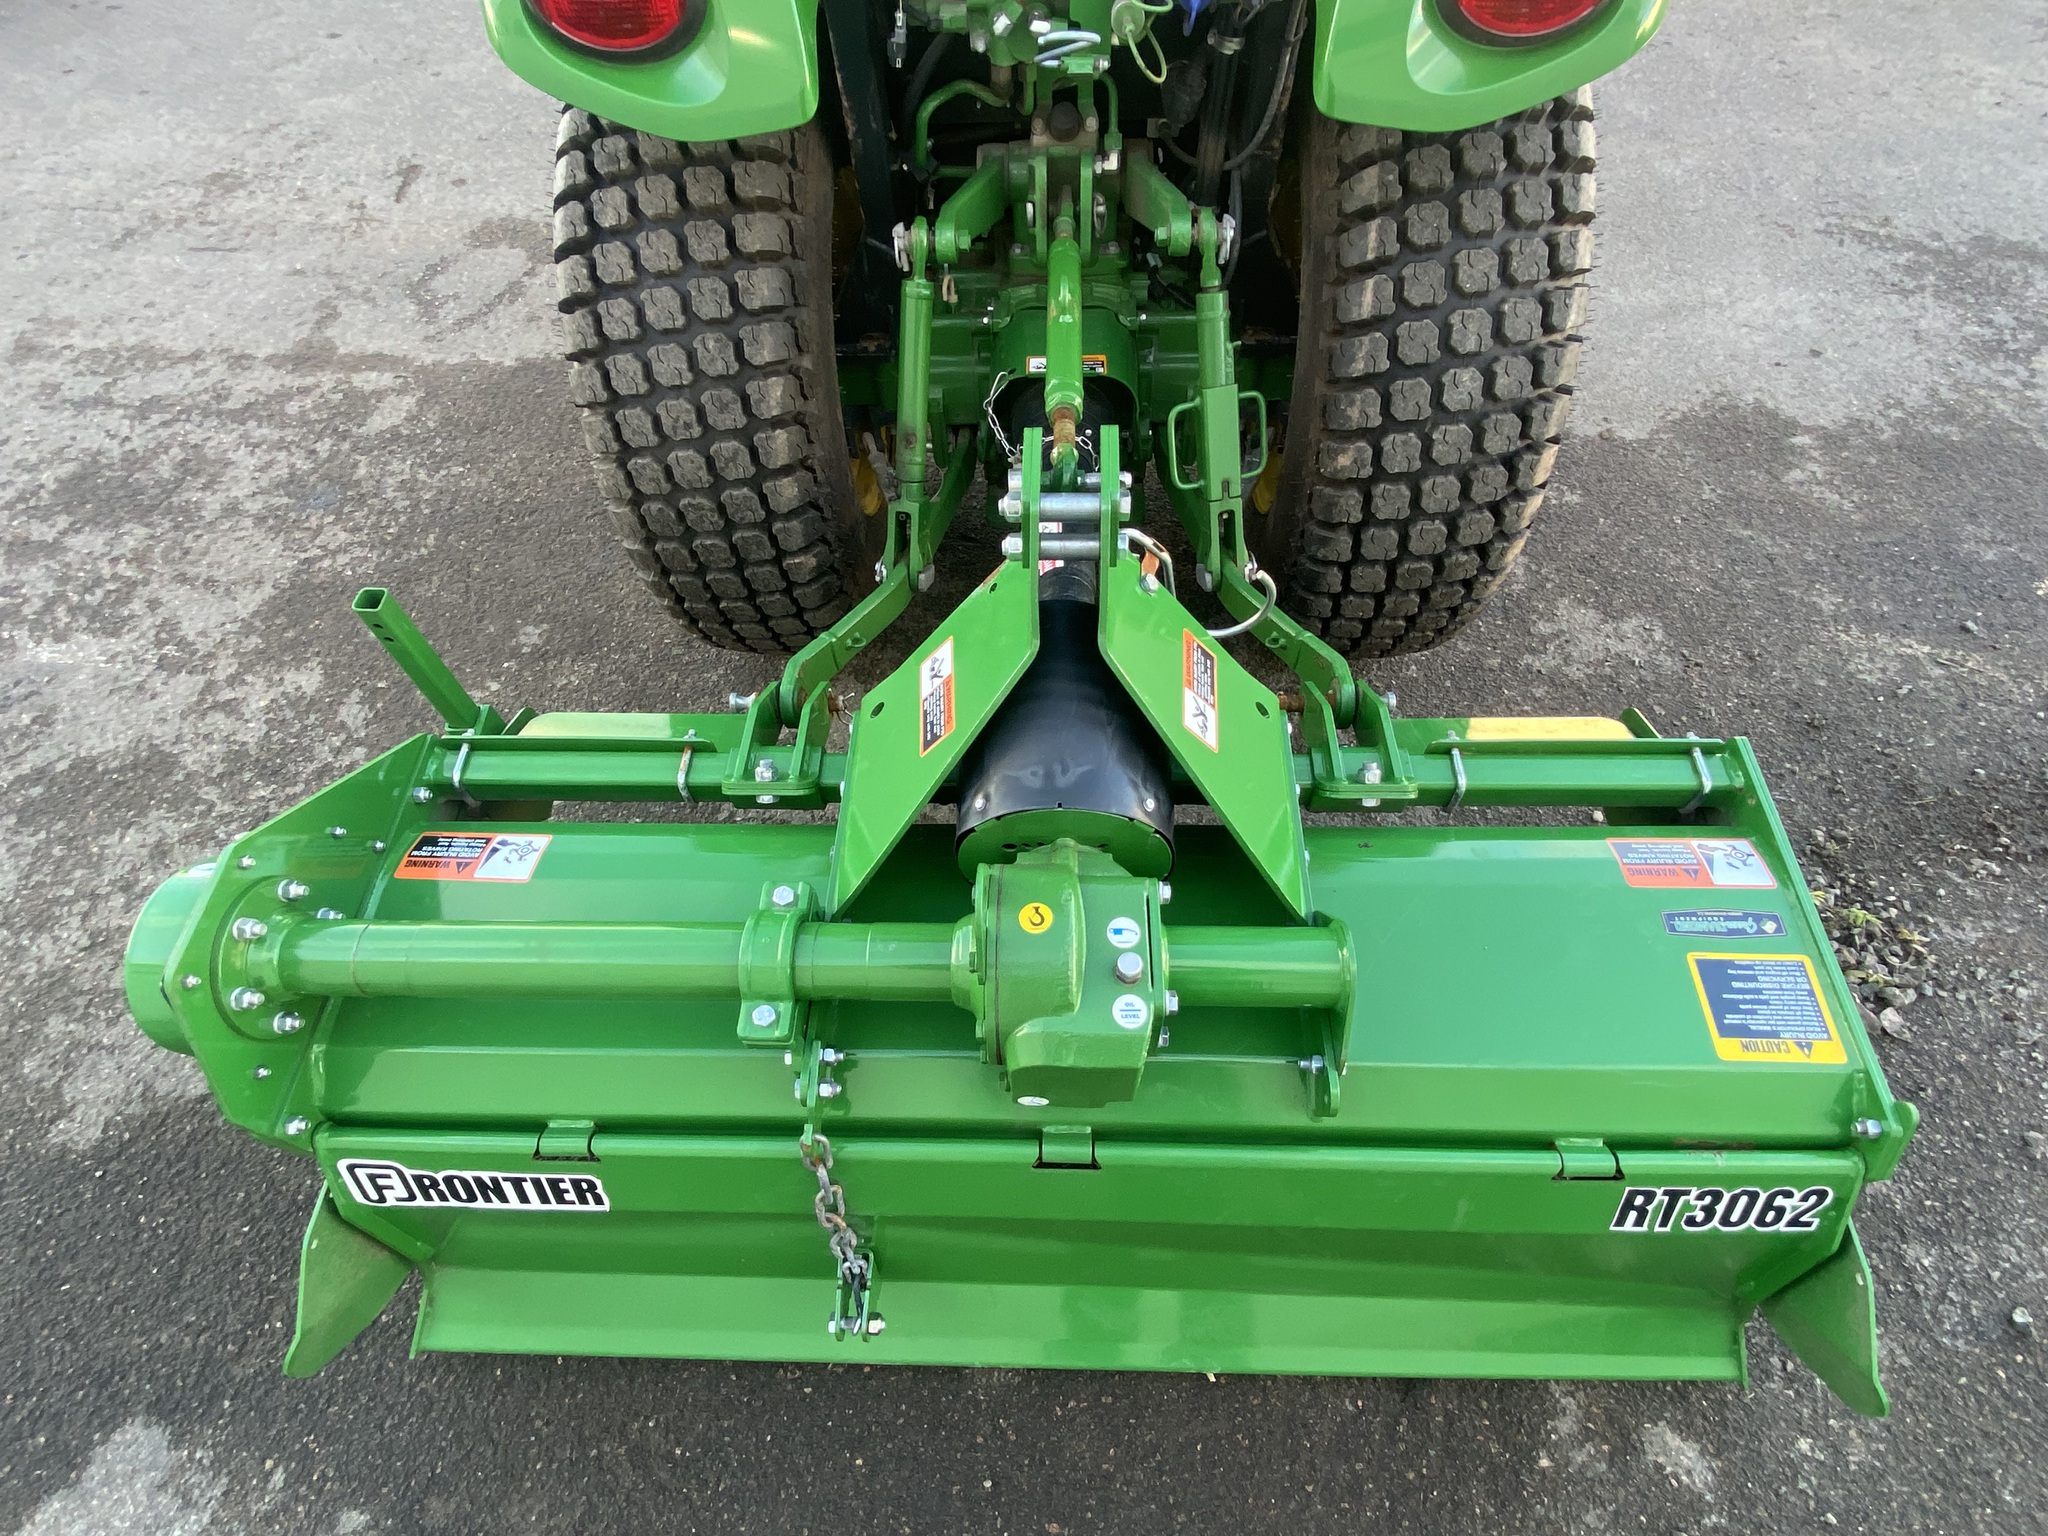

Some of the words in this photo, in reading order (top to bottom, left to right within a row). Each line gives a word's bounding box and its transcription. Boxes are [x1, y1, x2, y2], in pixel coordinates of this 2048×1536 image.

[404, 859, 450, 868] WARNING
[1627, 868, 1679, 876] WARNING
[1739, 1040, 1791, 1053] CAUTION
[345, 1162, 605, 1206] FRONTIER
[1612, 1188, 1829, 1228] RT3062
